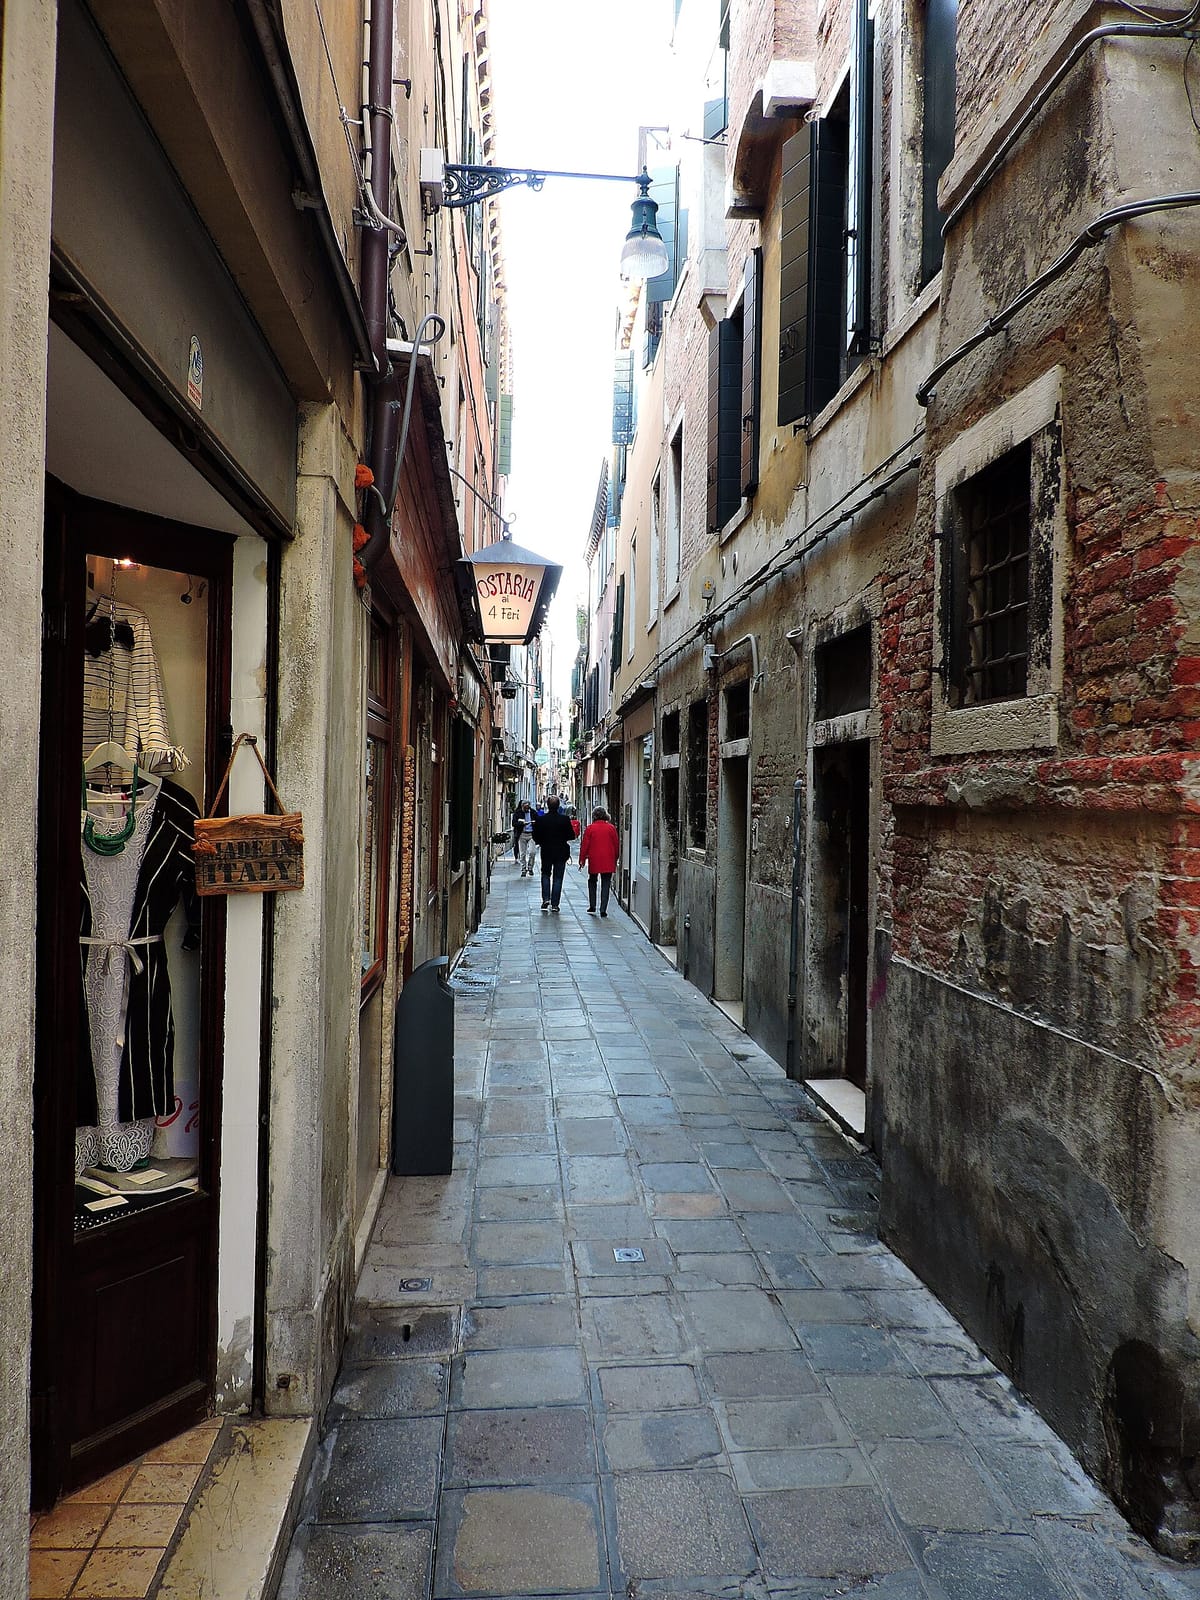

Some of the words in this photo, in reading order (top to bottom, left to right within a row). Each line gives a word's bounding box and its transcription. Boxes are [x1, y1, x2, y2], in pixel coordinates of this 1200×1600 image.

[477, 572, 535, 602] OSTARIA
[488, 605, 497, 619] 4
[501, 607, 520, 620] Feri
[206, 861, 292, 884] ITALY
